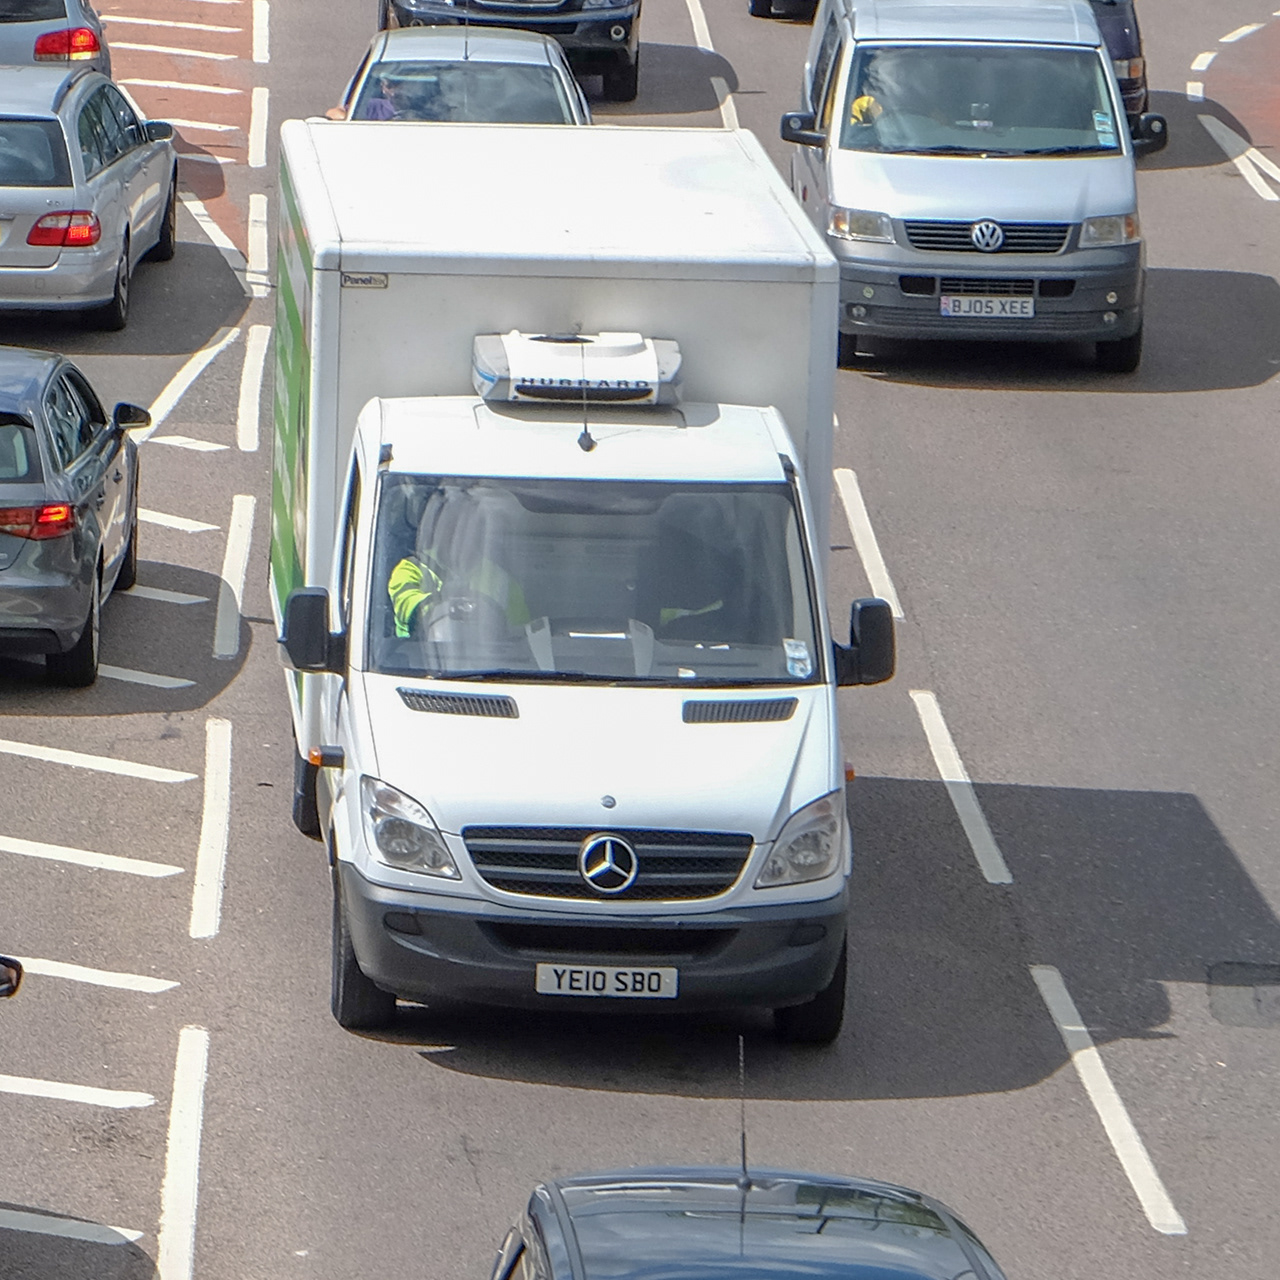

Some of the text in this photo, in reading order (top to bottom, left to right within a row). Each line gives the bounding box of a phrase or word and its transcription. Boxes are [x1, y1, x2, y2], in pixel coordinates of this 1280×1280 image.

[952, 299, 1030, 315] BJ05 XEE
[552, 968, 662, 993] YE10 SBO
